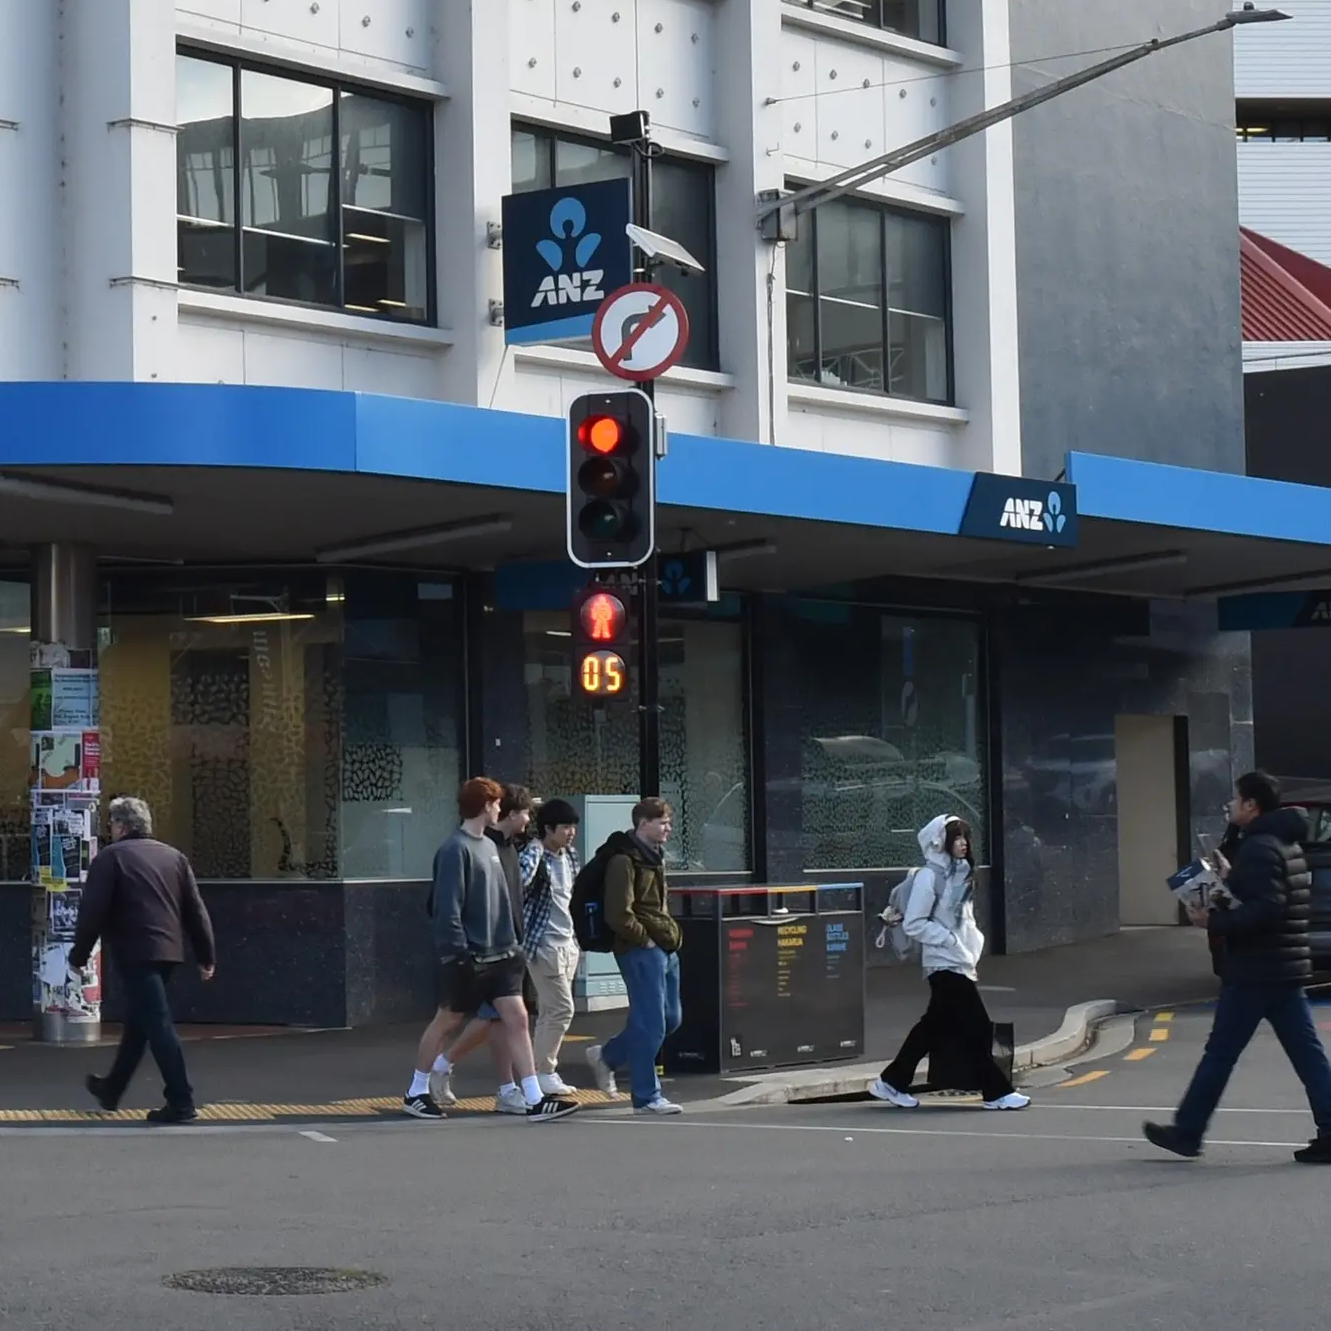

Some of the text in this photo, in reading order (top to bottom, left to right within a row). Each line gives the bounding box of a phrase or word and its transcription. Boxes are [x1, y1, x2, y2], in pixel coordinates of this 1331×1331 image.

[530, 268, 605, 308] ANZ
[999, 497, 1044, 531] ANZ
[583, 656, 621, 692] 05
